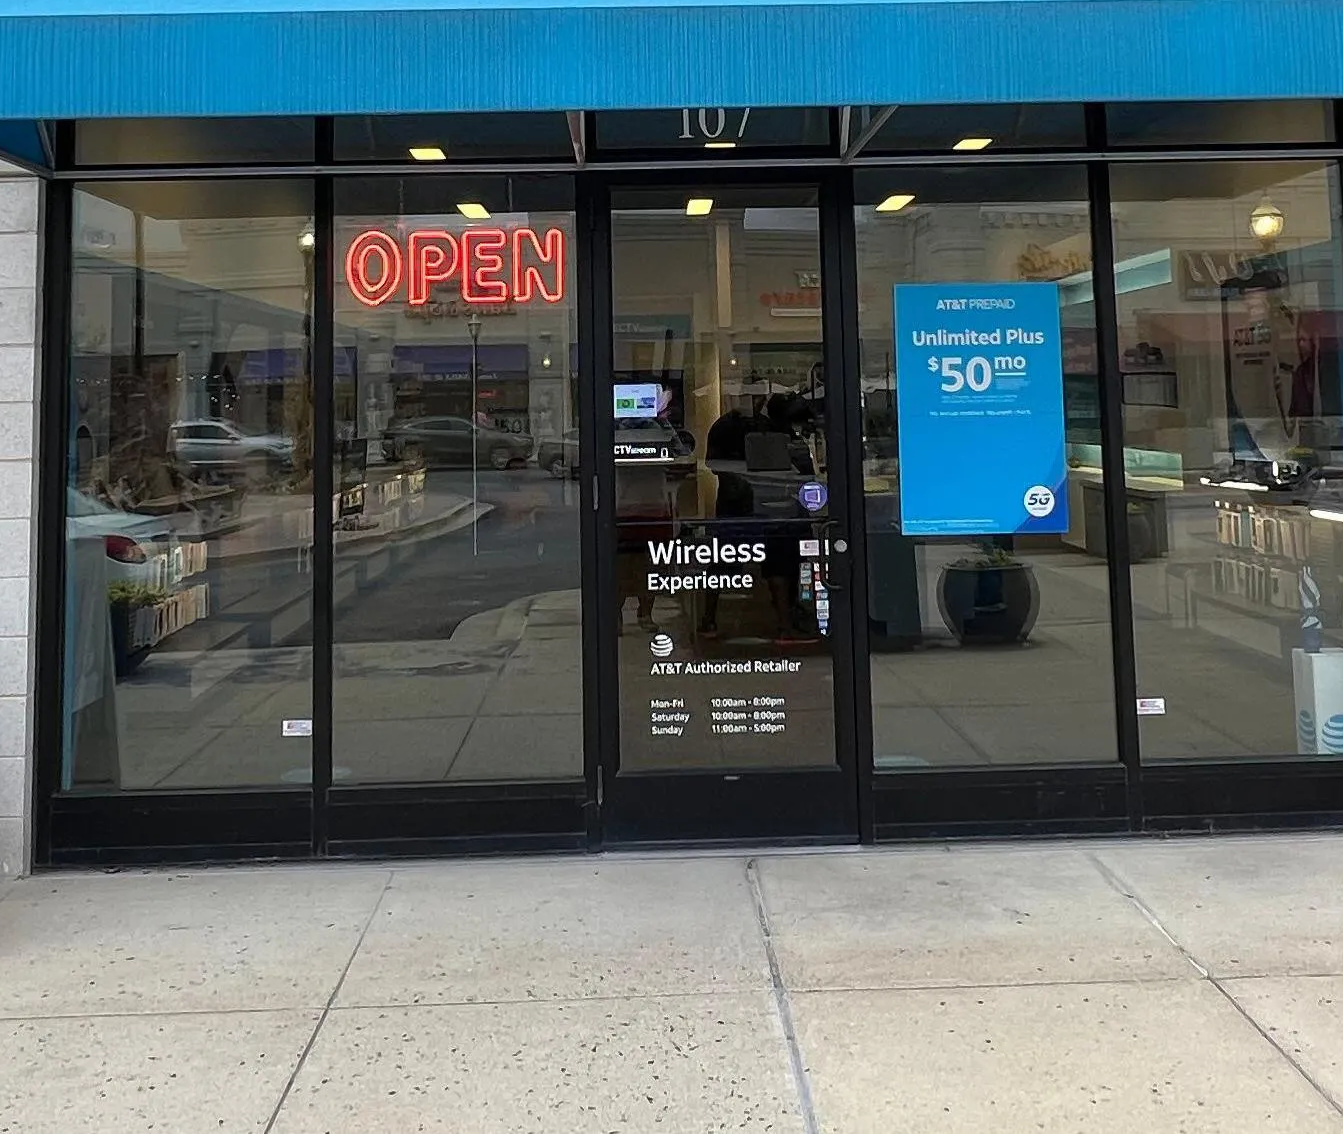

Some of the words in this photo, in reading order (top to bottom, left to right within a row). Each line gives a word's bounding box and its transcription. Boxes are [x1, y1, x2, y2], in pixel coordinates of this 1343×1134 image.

[345, 227, 565, 307] OPEN
[936, 299, 968, 310] AT&T
[969, 298, 1015, 309] PREPAID
[912, 329, 1002, 346] Unlimited
[1006, 328, 1044, 345] Plus
[994, 355, 1026, 371] mo
[1027, 493, 1051, 506] 5G
[647, 538, 767, 566] Wireless
[647, 571, 754, 595] Experience
[650, 663, 683, 675] AT&T
[684, 661, 752, 675] Authorized
[754, 659, 802, 673] Retailer
[650, 698, 685, 709] Mon-Fri
[651, 712, 690, 723] Saturday
[651, 724, 684, 736] Sunday
